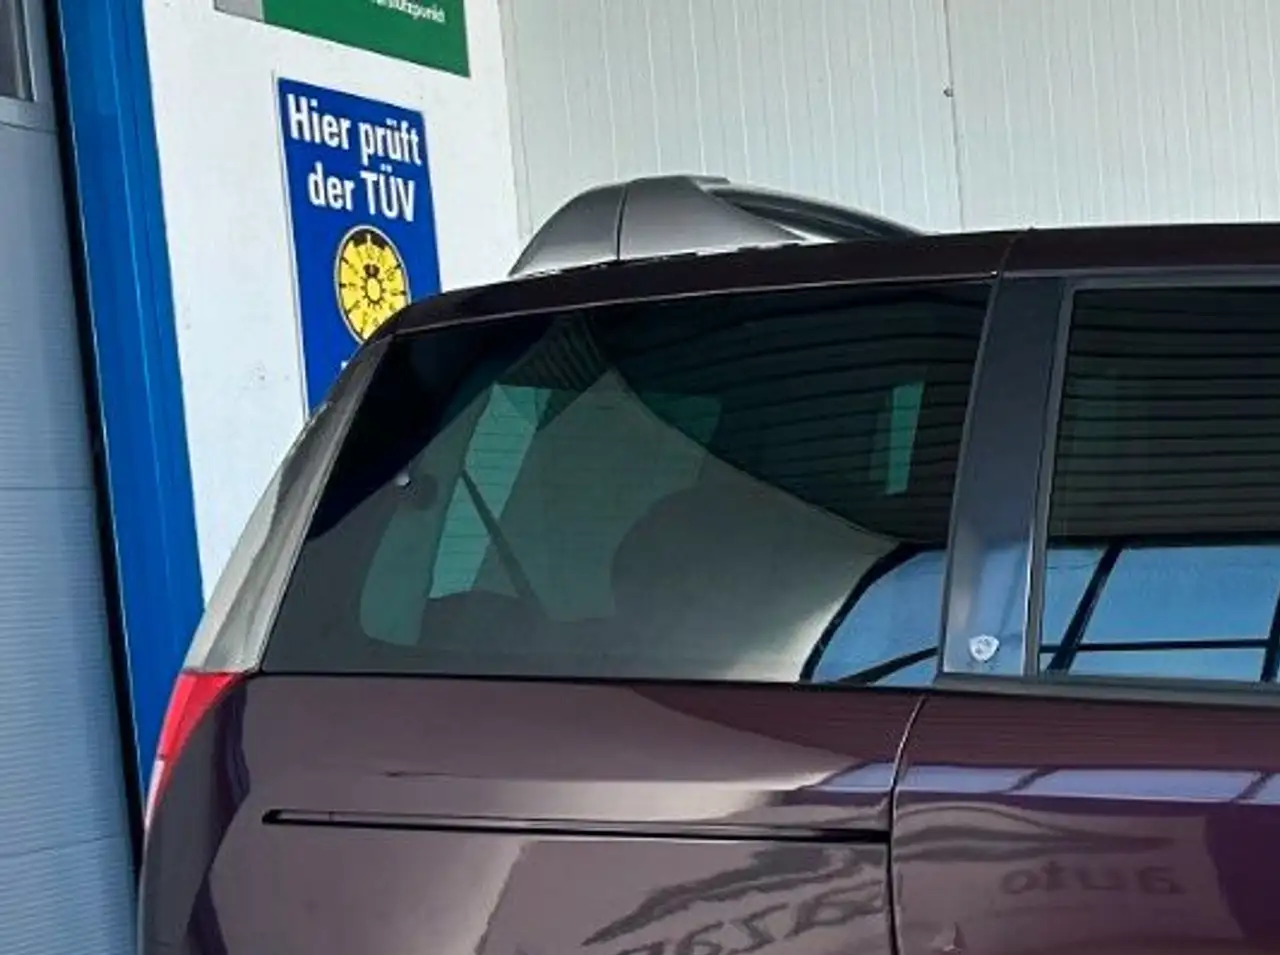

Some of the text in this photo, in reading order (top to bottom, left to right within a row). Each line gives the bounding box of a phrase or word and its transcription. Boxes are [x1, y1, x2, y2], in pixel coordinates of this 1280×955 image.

[286, 93, 423, 167] Hier prüft
[308, 160, 416, 222] der TÜV
